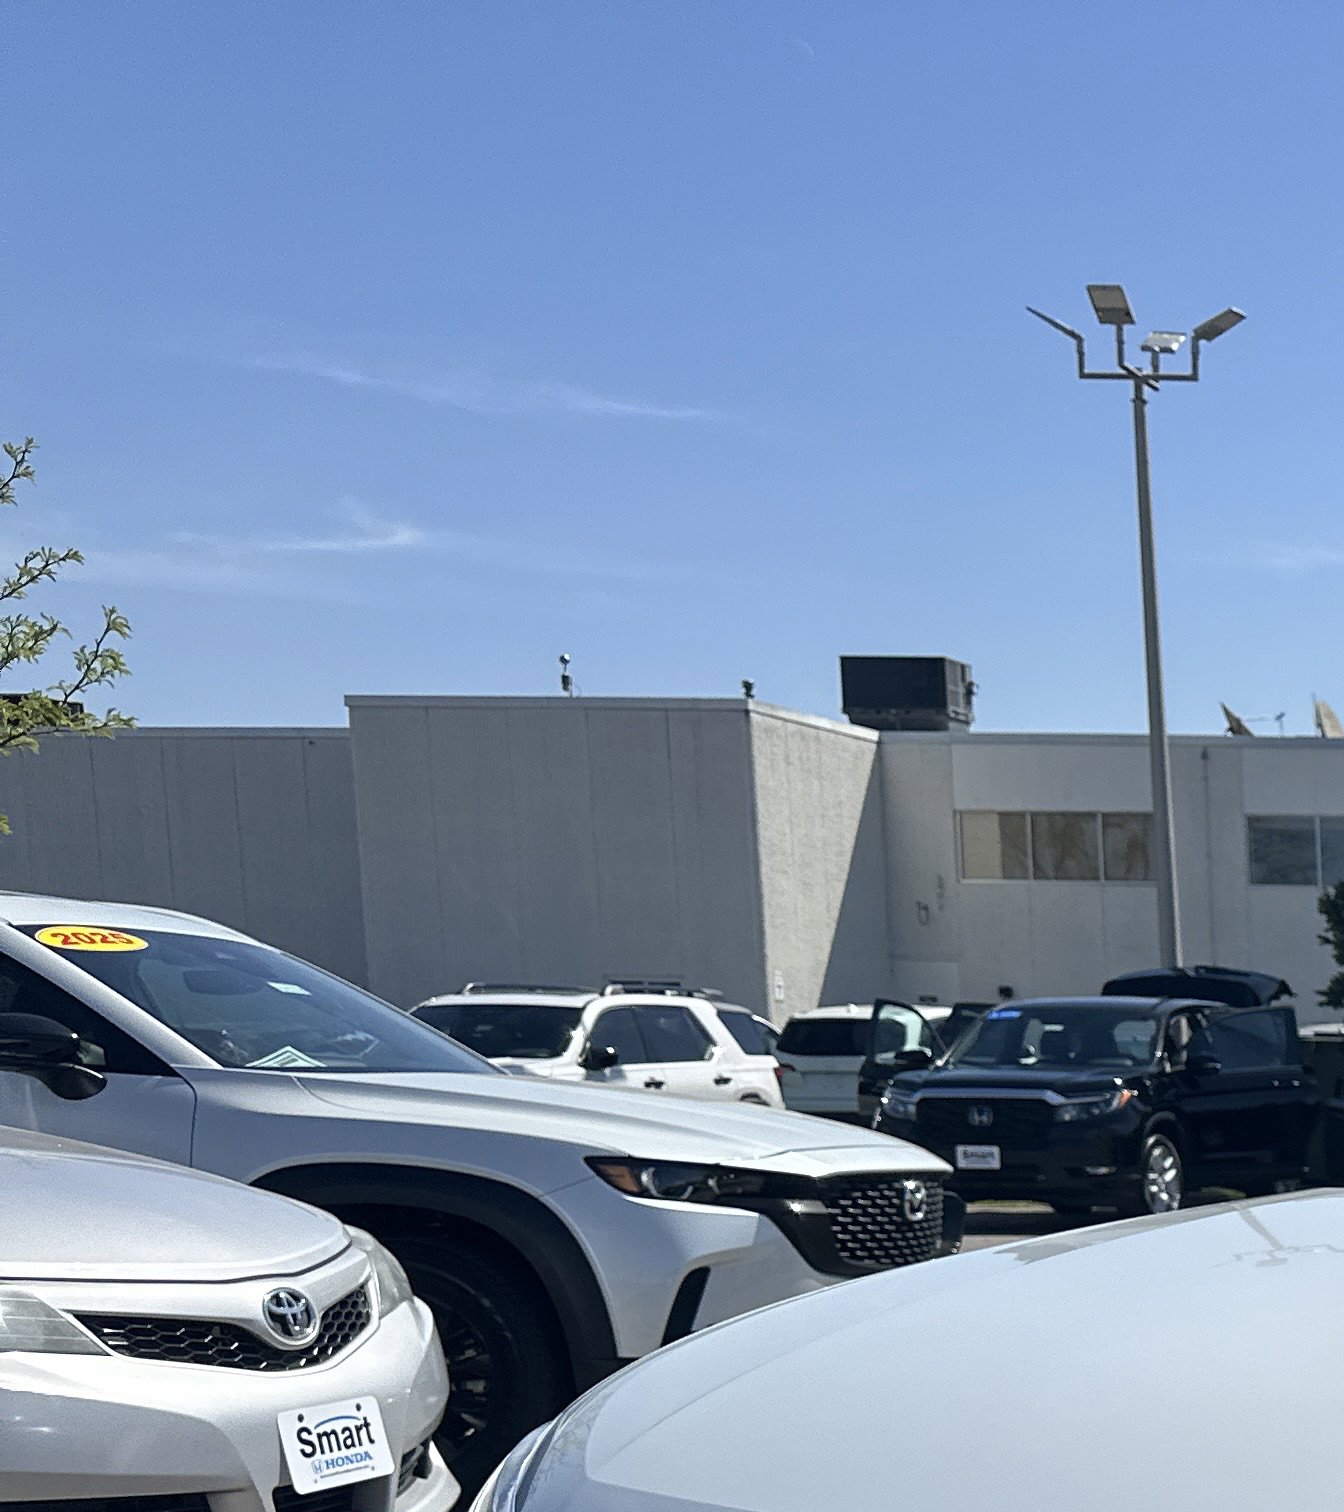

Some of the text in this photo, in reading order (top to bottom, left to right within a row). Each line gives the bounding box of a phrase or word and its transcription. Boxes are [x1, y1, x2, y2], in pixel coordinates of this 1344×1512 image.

[50, 932, 134, 945] 2025
[296, 1416, 375, 1458] Smart
[324, 1451, 373, 1470] HONDA
